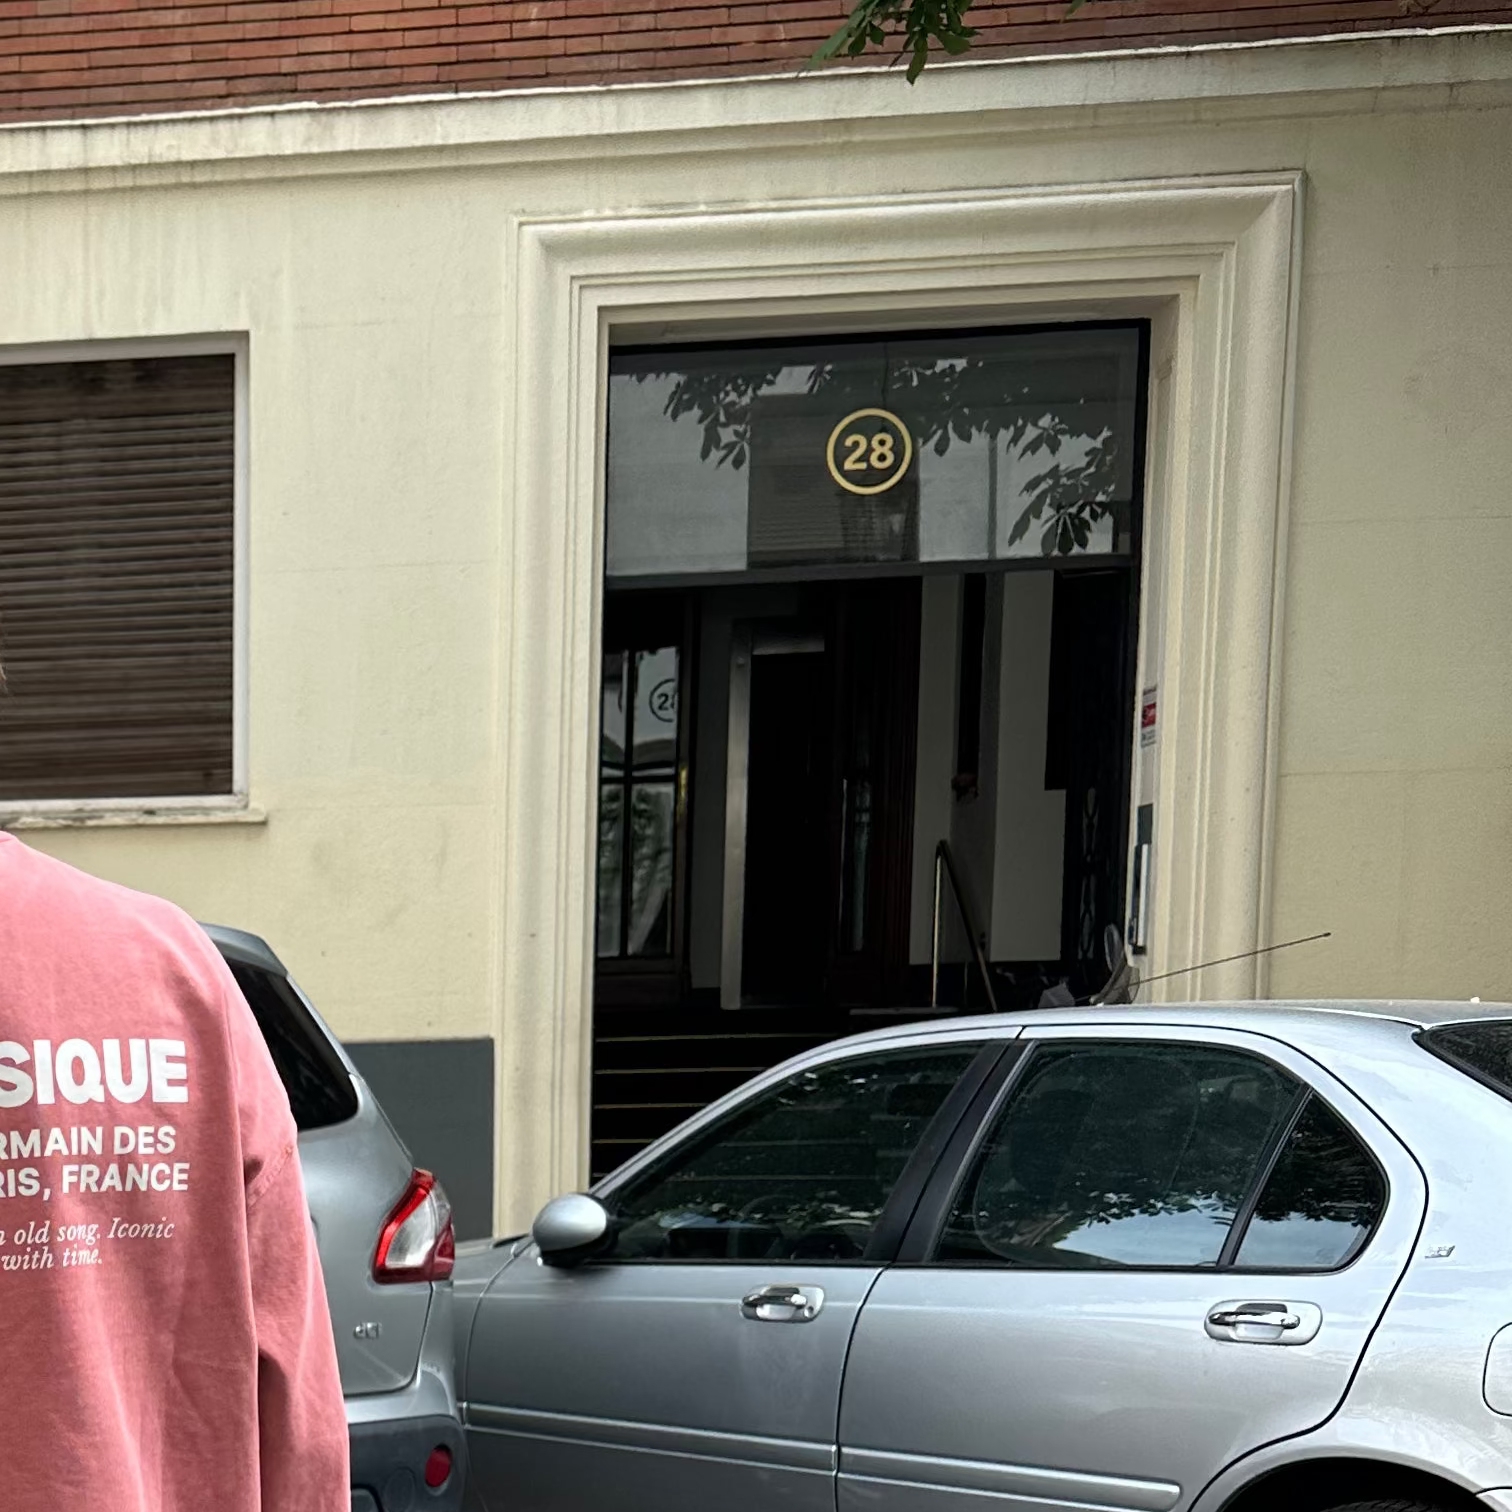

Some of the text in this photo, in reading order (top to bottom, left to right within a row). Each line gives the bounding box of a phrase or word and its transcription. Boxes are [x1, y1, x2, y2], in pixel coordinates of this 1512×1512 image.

[843, 432, 895, 471] 28
[113, 1125, 177, 1155] DES
[62, 1162, 190, 1194] FRANCE
[14, 1220, 52, 1246] old
[57, 1222, 102, 1247] song.
[107, 1217, 176, 1240] Iconic
[1, 1246, 55, 1271] with
[61, 1244, 104, 1268] time.
